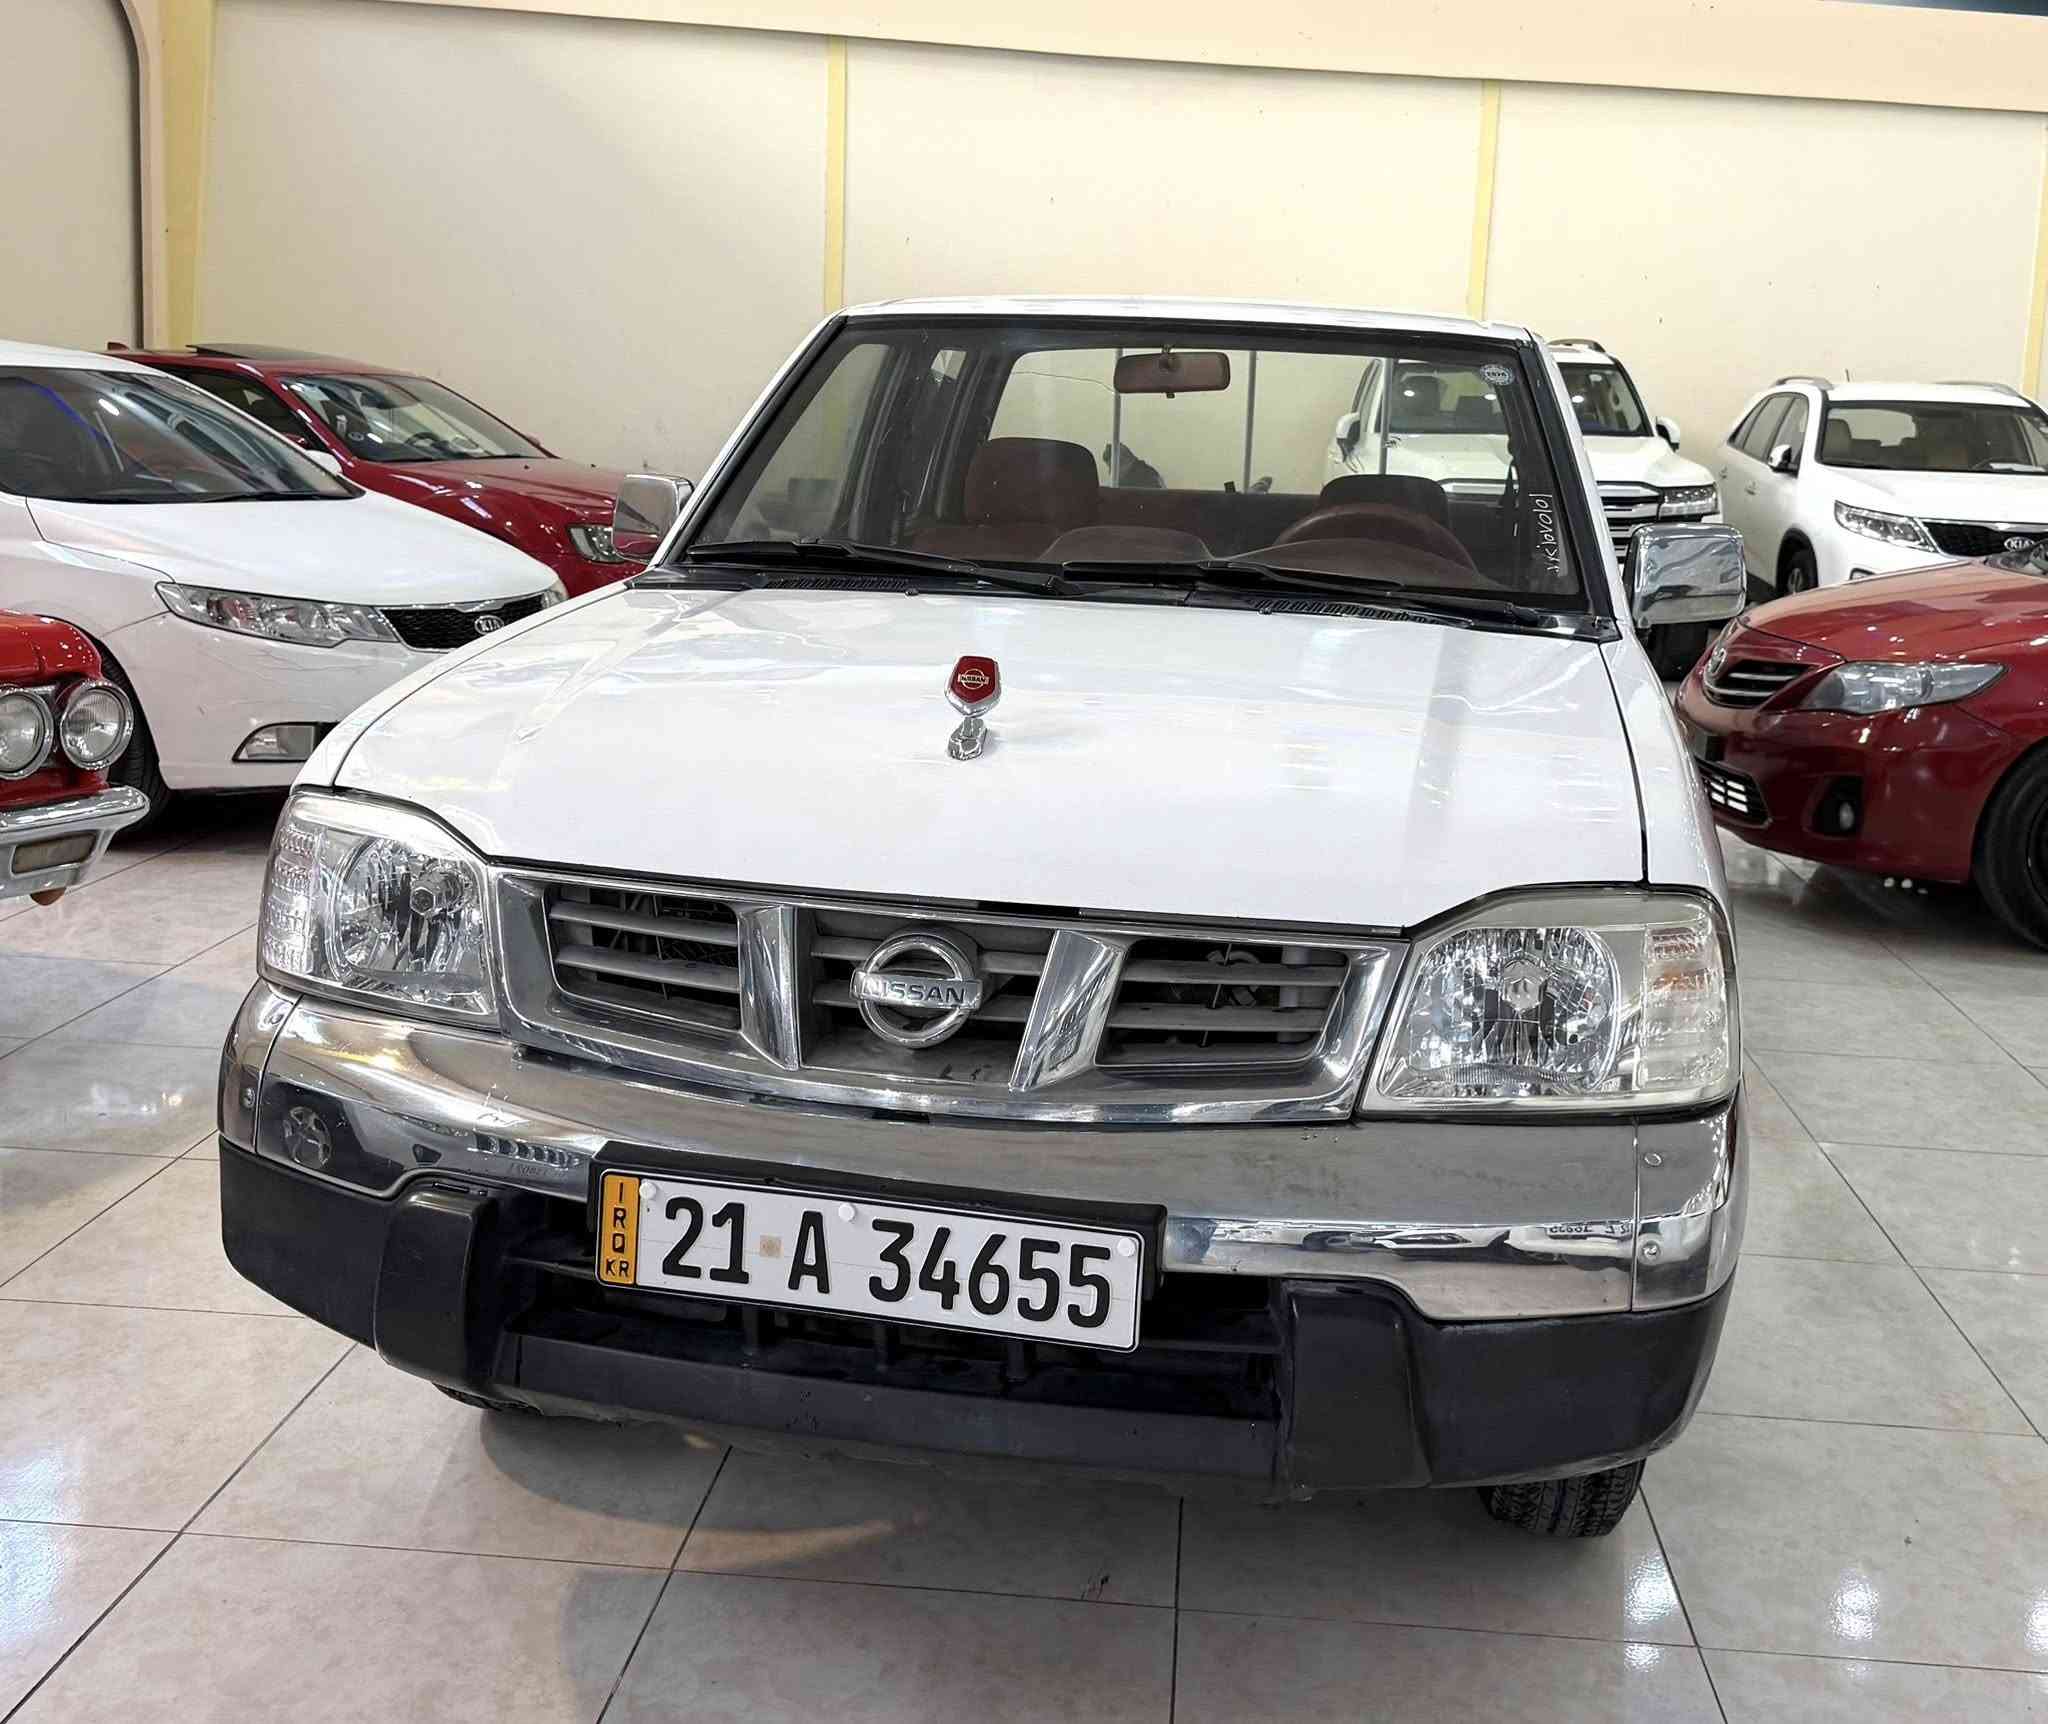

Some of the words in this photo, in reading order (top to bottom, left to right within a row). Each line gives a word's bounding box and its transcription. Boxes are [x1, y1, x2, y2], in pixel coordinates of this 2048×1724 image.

[2007, 538, 2032, 550] KIA
[477, 617, 502, 632] KIA
[863, 978, 965, 1004] NISSAN
[605, 1258, 629, 1278] KR
[662, 1196, 749, 1285] 21
[788, 1210, 830, 1295] A
[868, 1218, 1111, 1329] 34655
